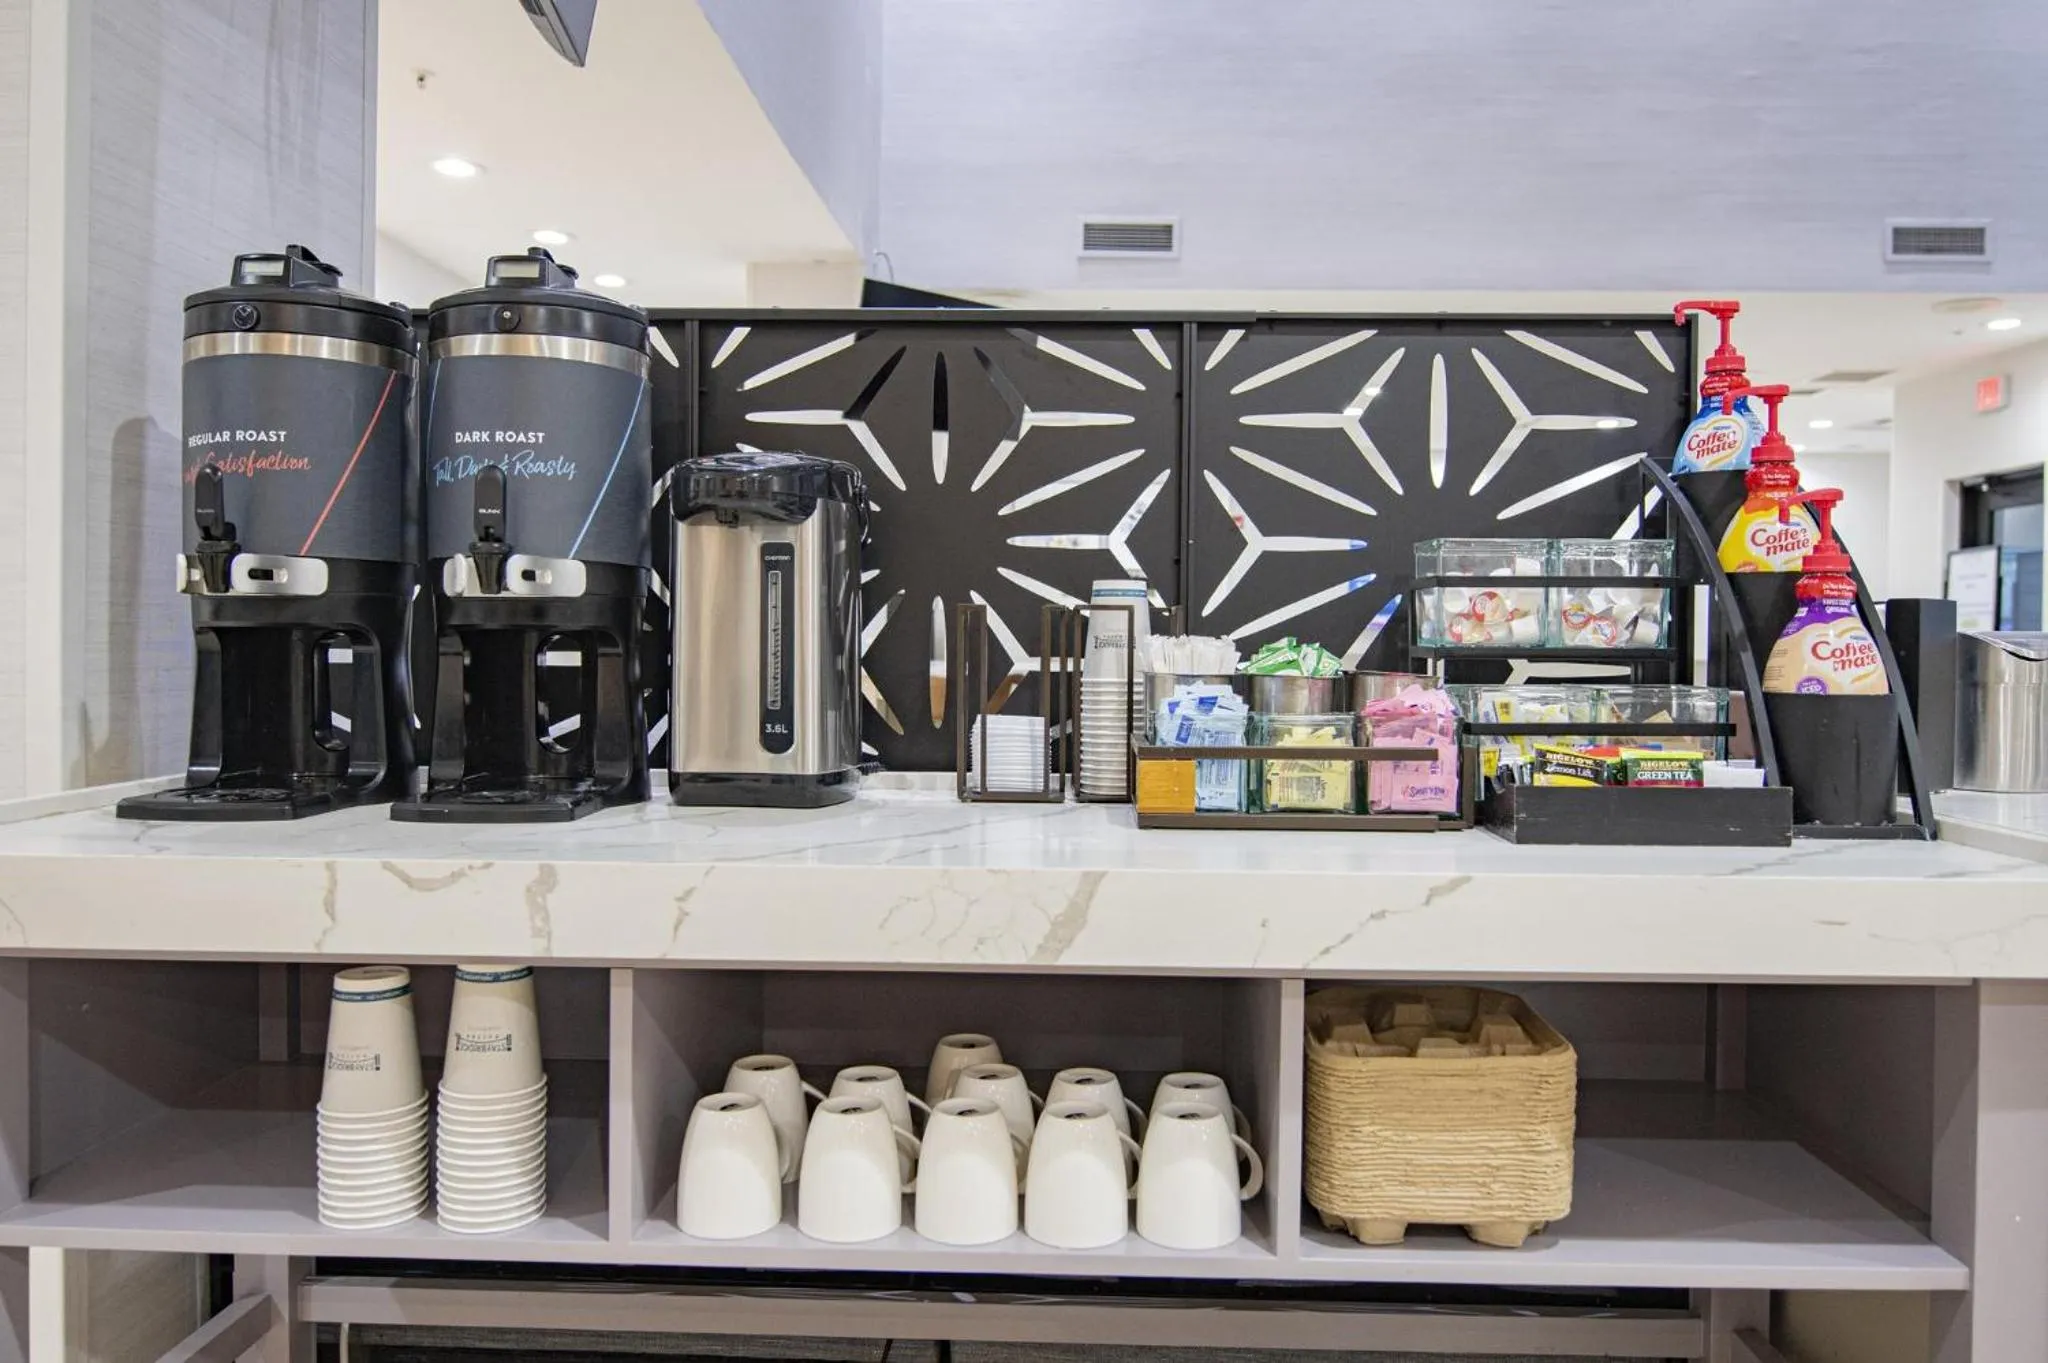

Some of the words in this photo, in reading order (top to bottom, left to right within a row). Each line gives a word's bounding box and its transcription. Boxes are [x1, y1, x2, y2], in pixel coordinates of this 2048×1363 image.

[187, 430, 231, 448] REGULAR
[235, 429, 287, 443] ROAST
[455, 430, 490, 444] DARK
[495, 430, 546, 444] ROAST
[1695, 439, 1738, 460] mate
[511, 449, 577, 480] Roasty
[1751, 528, 1806, 547] Coffee
[1766, 539, 1810, 557] mate
[1811, 642, 1874, 661] Coffee
[1832, 654, 1877, 672] mate
[765, 723, 789, 734] 3.6L
[1636, 771, 1673, 781] GREEN
[1674, 771, 1694, 781] TEA
